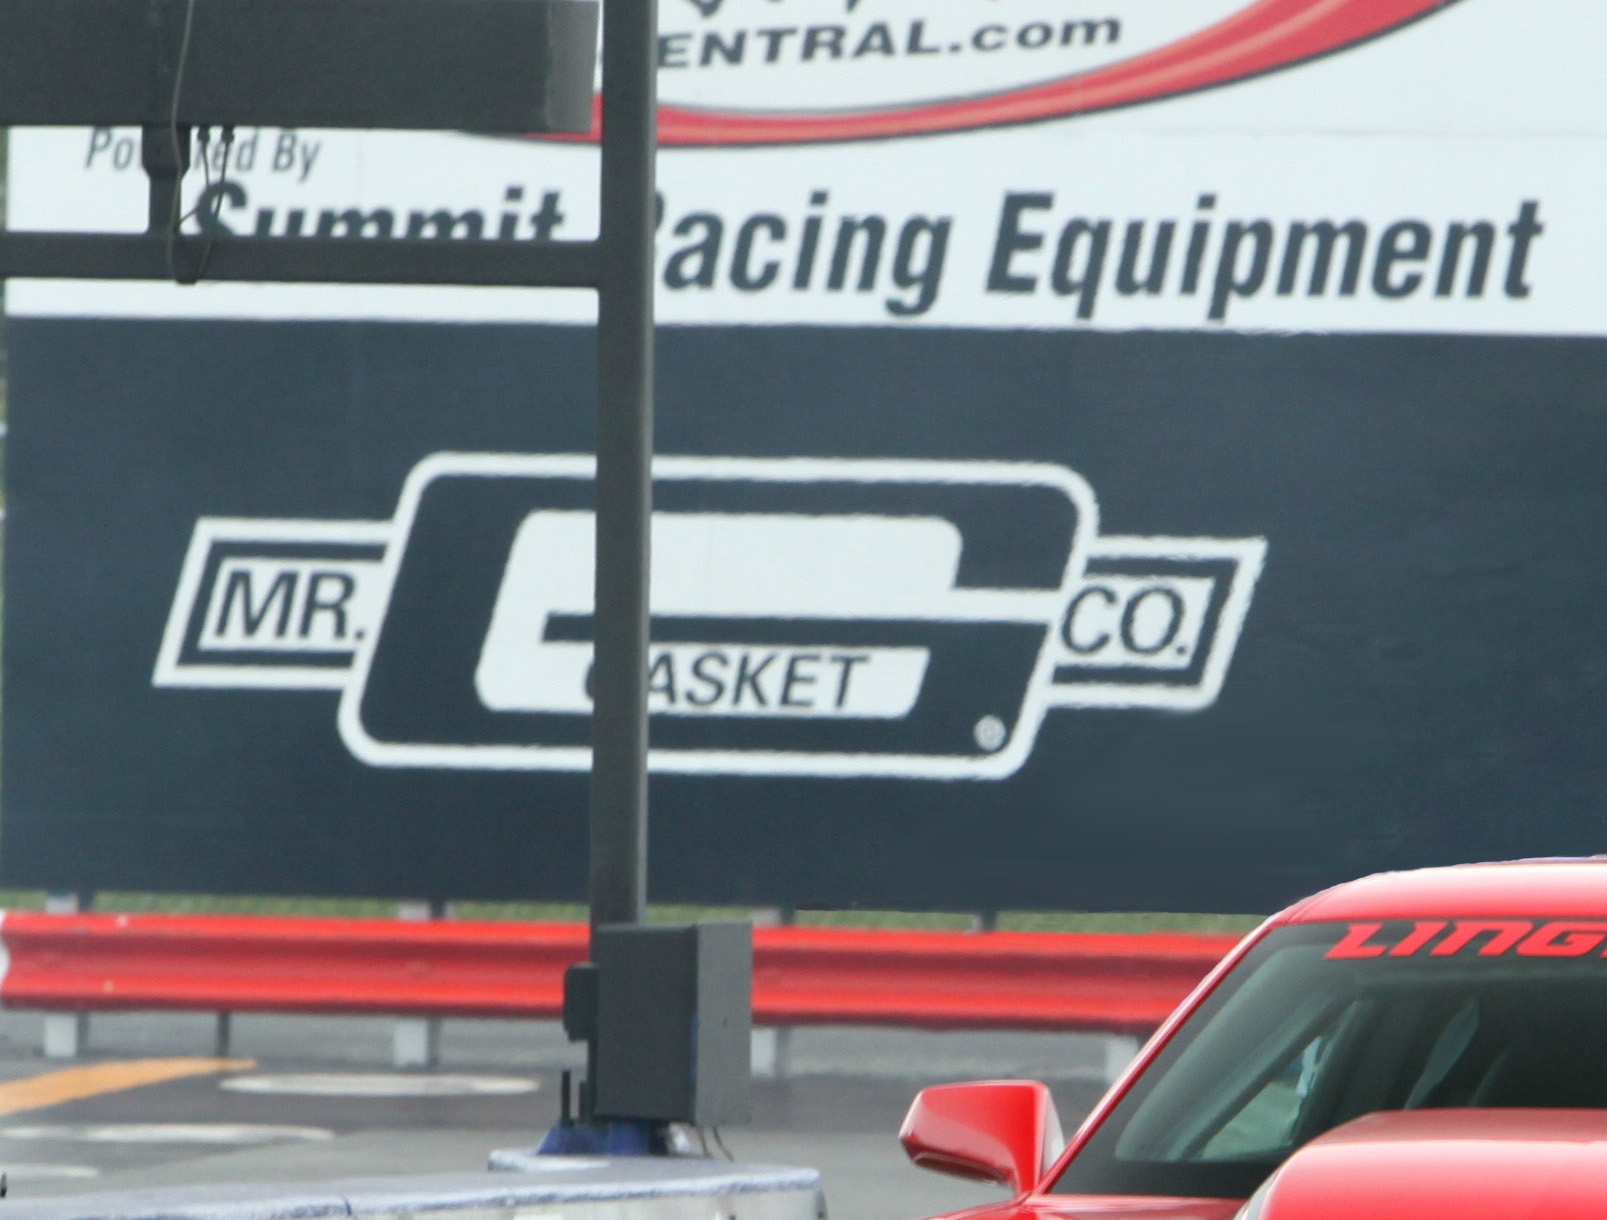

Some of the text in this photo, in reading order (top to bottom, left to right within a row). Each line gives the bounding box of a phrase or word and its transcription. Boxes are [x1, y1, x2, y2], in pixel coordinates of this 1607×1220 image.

[656, 17, 1123, 70] ENTRAL.com
[272, 129, 321, 183] By
[655, 189, 953, 317] acing
[985, 191, 1545, 321] Equipment
[213, 568, 1187, 709] MR. ASKET CO.
